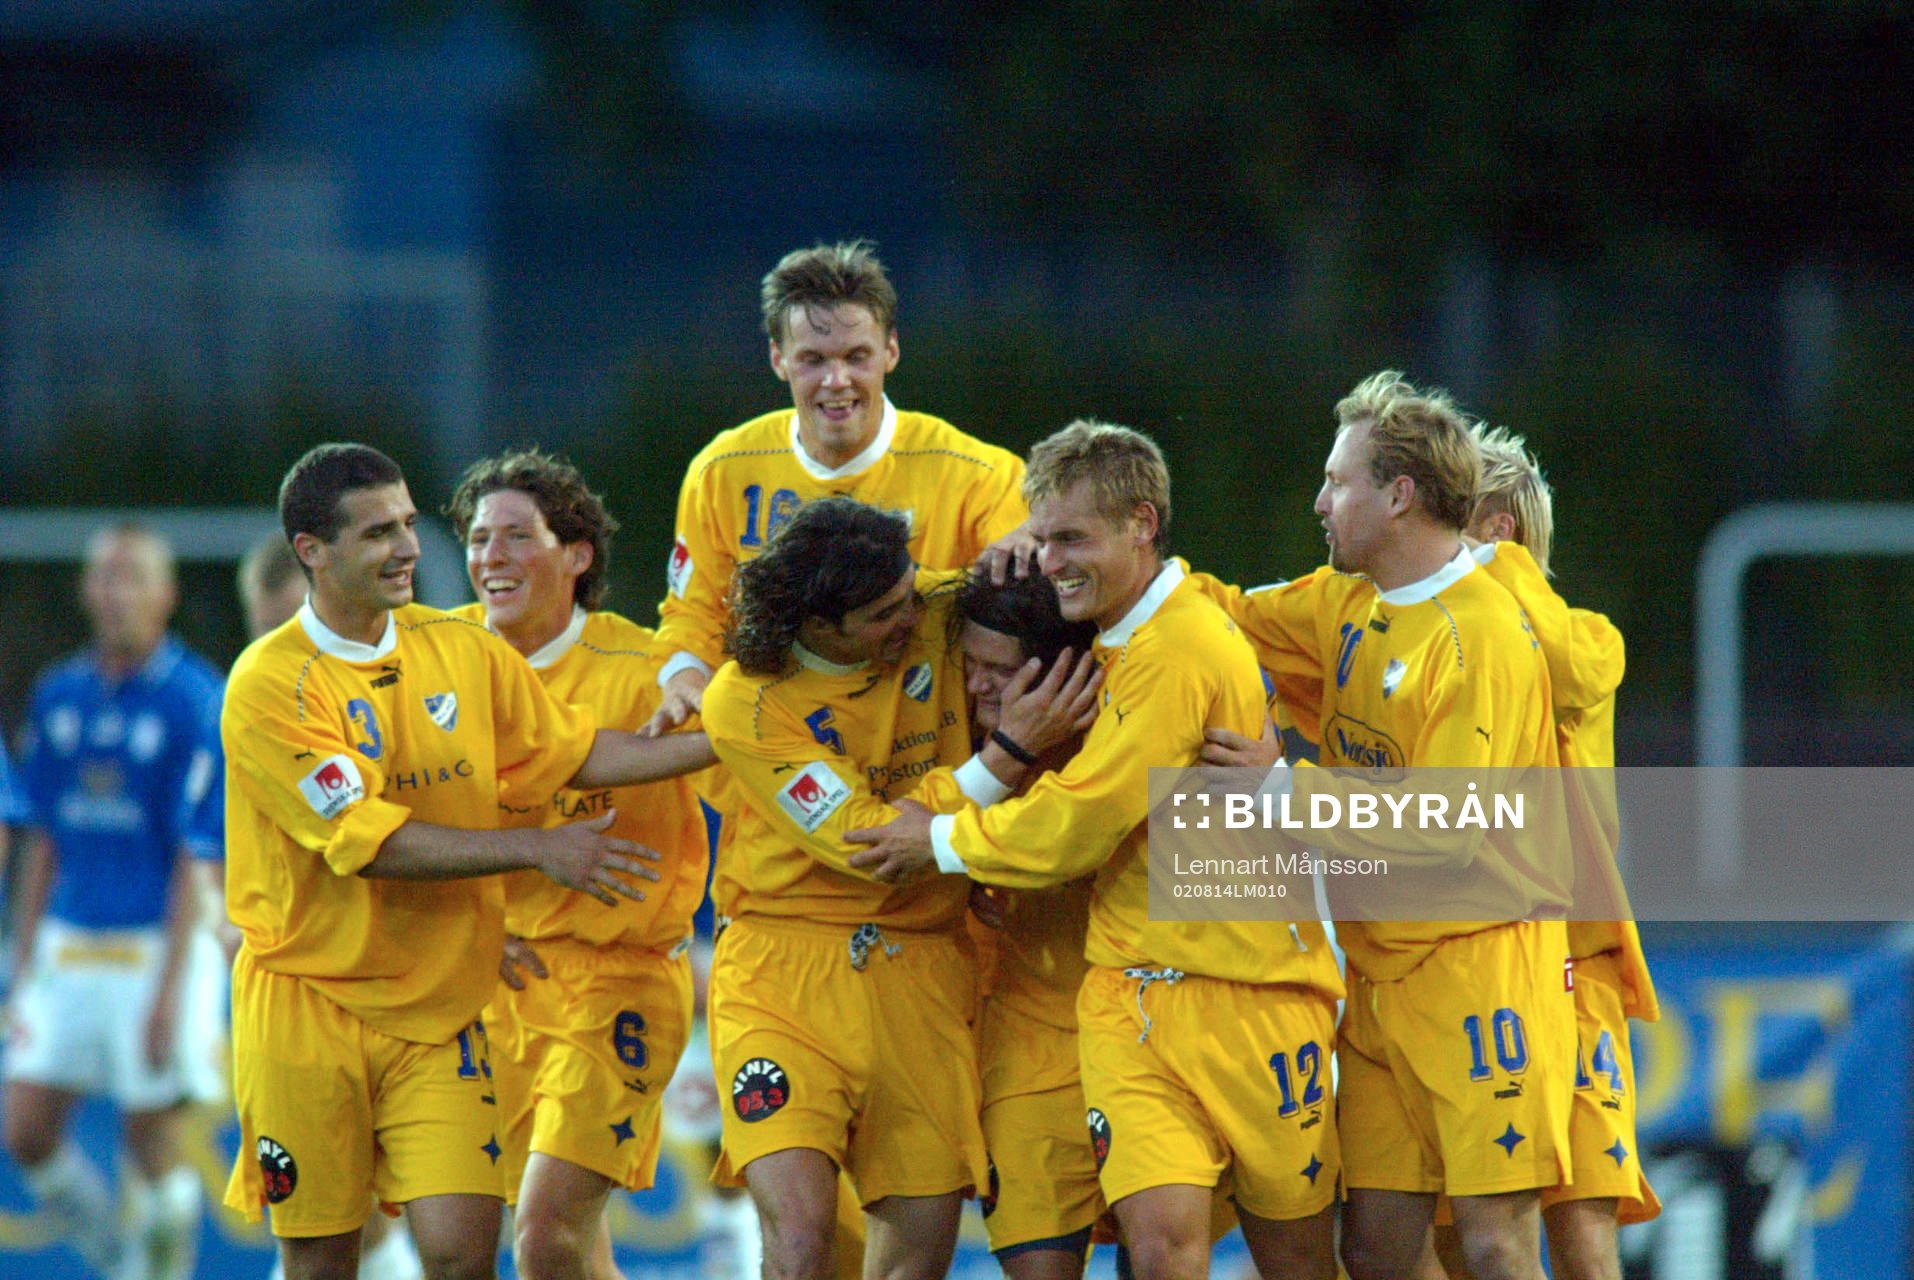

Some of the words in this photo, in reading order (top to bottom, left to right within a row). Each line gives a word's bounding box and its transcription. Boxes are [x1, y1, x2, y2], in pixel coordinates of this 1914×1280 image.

[614, 1010, 650, 1071] 6
[1463, 1008, 1531, 1082] 10
[733, 1060, 784, 1096] VINYL
[1269, 1040, 1325, 1119] 12
